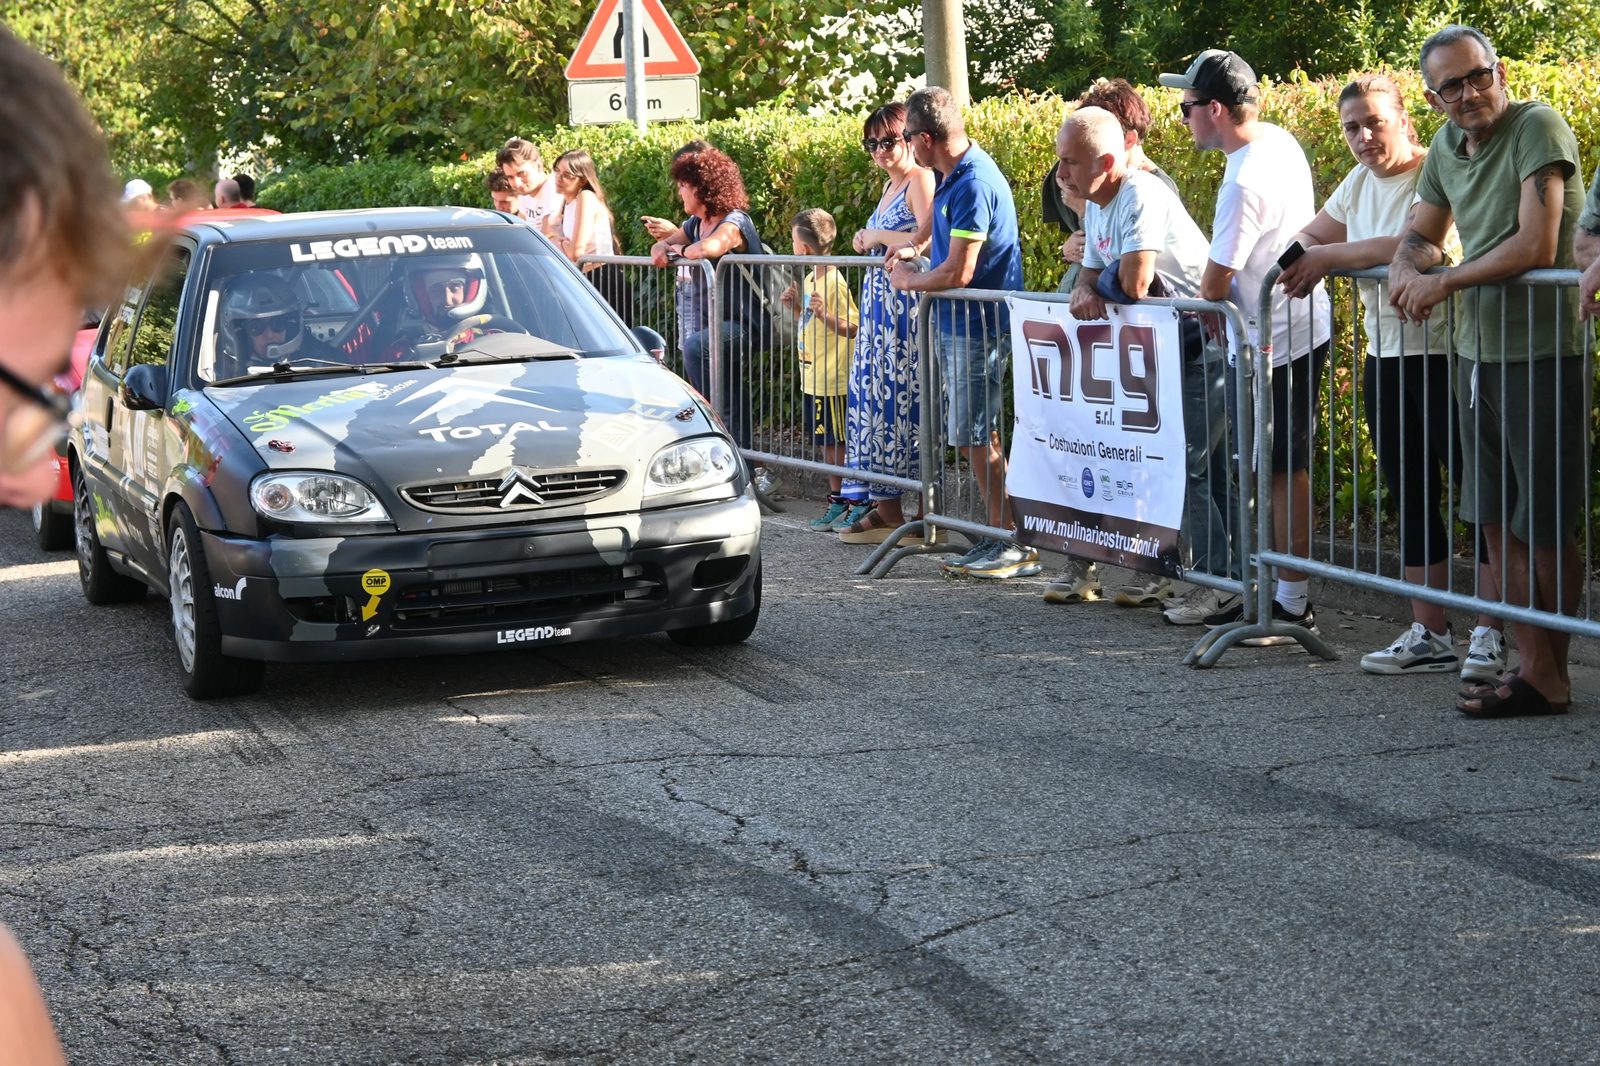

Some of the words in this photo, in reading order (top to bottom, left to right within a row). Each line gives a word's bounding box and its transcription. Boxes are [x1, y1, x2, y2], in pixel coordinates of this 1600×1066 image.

[609, 93, 628, 111] 6
[647, 98, 662, 110] m
[290, 234, 427, 262] LEGEND
[427, 234, 473, 250] team
[1095, 408, 1115, 426] s.r.l.
[418, 420, 568, 442] TOTAL
[1098, 441, 1142, 463] Generali
[1024, 515, 1160, 559] www.mulinaricostruzioni.it
[366, 577, 387, 586] OMP
[214, 582, 235, 600] alcon
[497, 626, 554, 644] LEGEND
[554, 627, 571, 637] team
